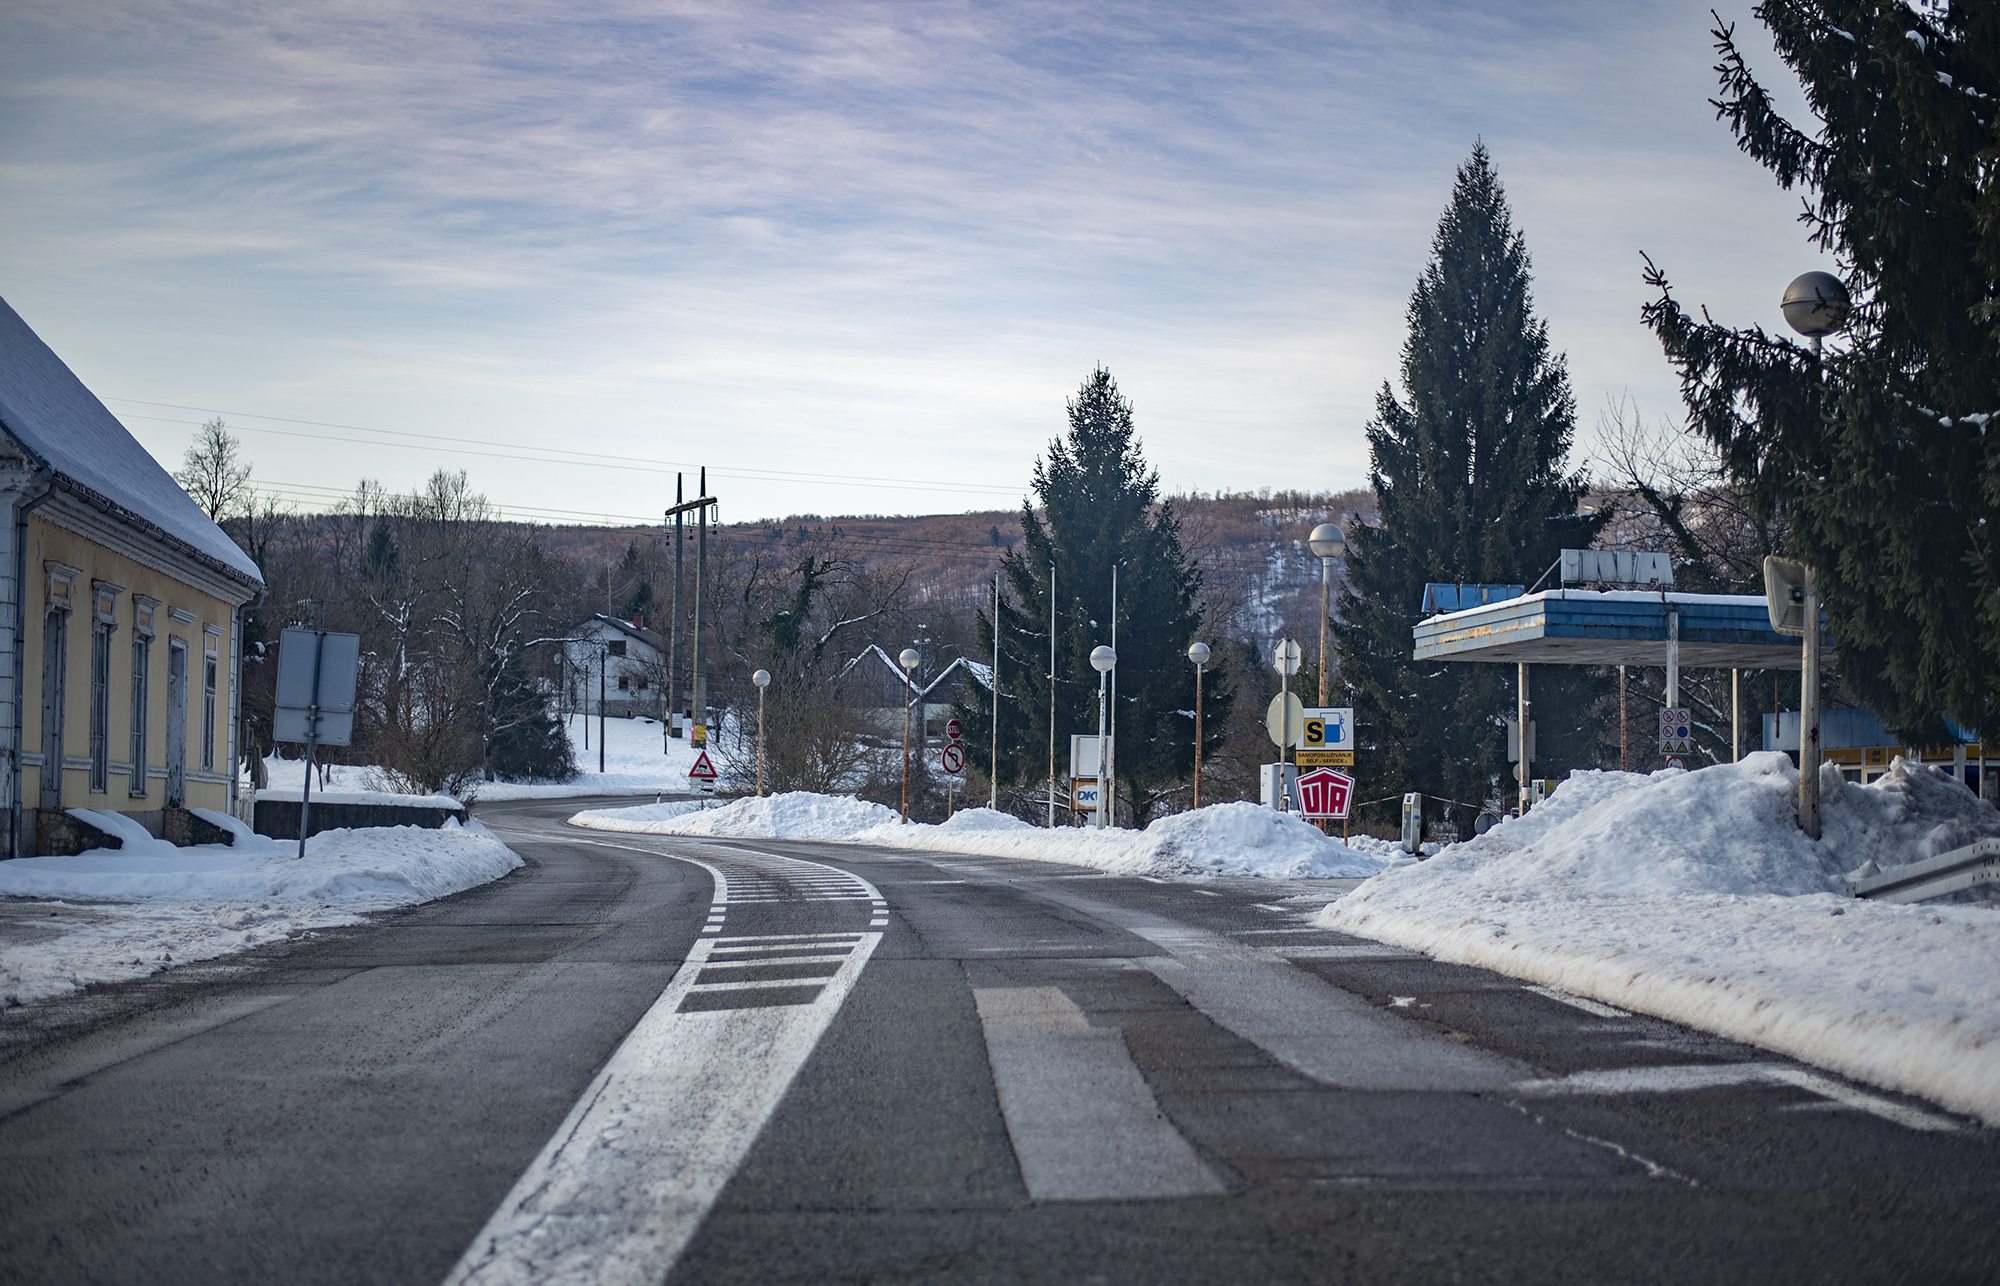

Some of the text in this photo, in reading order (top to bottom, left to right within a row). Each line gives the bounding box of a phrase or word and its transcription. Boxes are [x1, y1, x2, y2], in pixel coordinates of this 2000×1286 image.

[1561, 548, 1674, 584] INA
[949, 726, 960, 734] STO
[1307, 721, 1323, 742] S
[1078, 791, 1097, 801] DK
[1300, 772, 1350, 814] UTA
